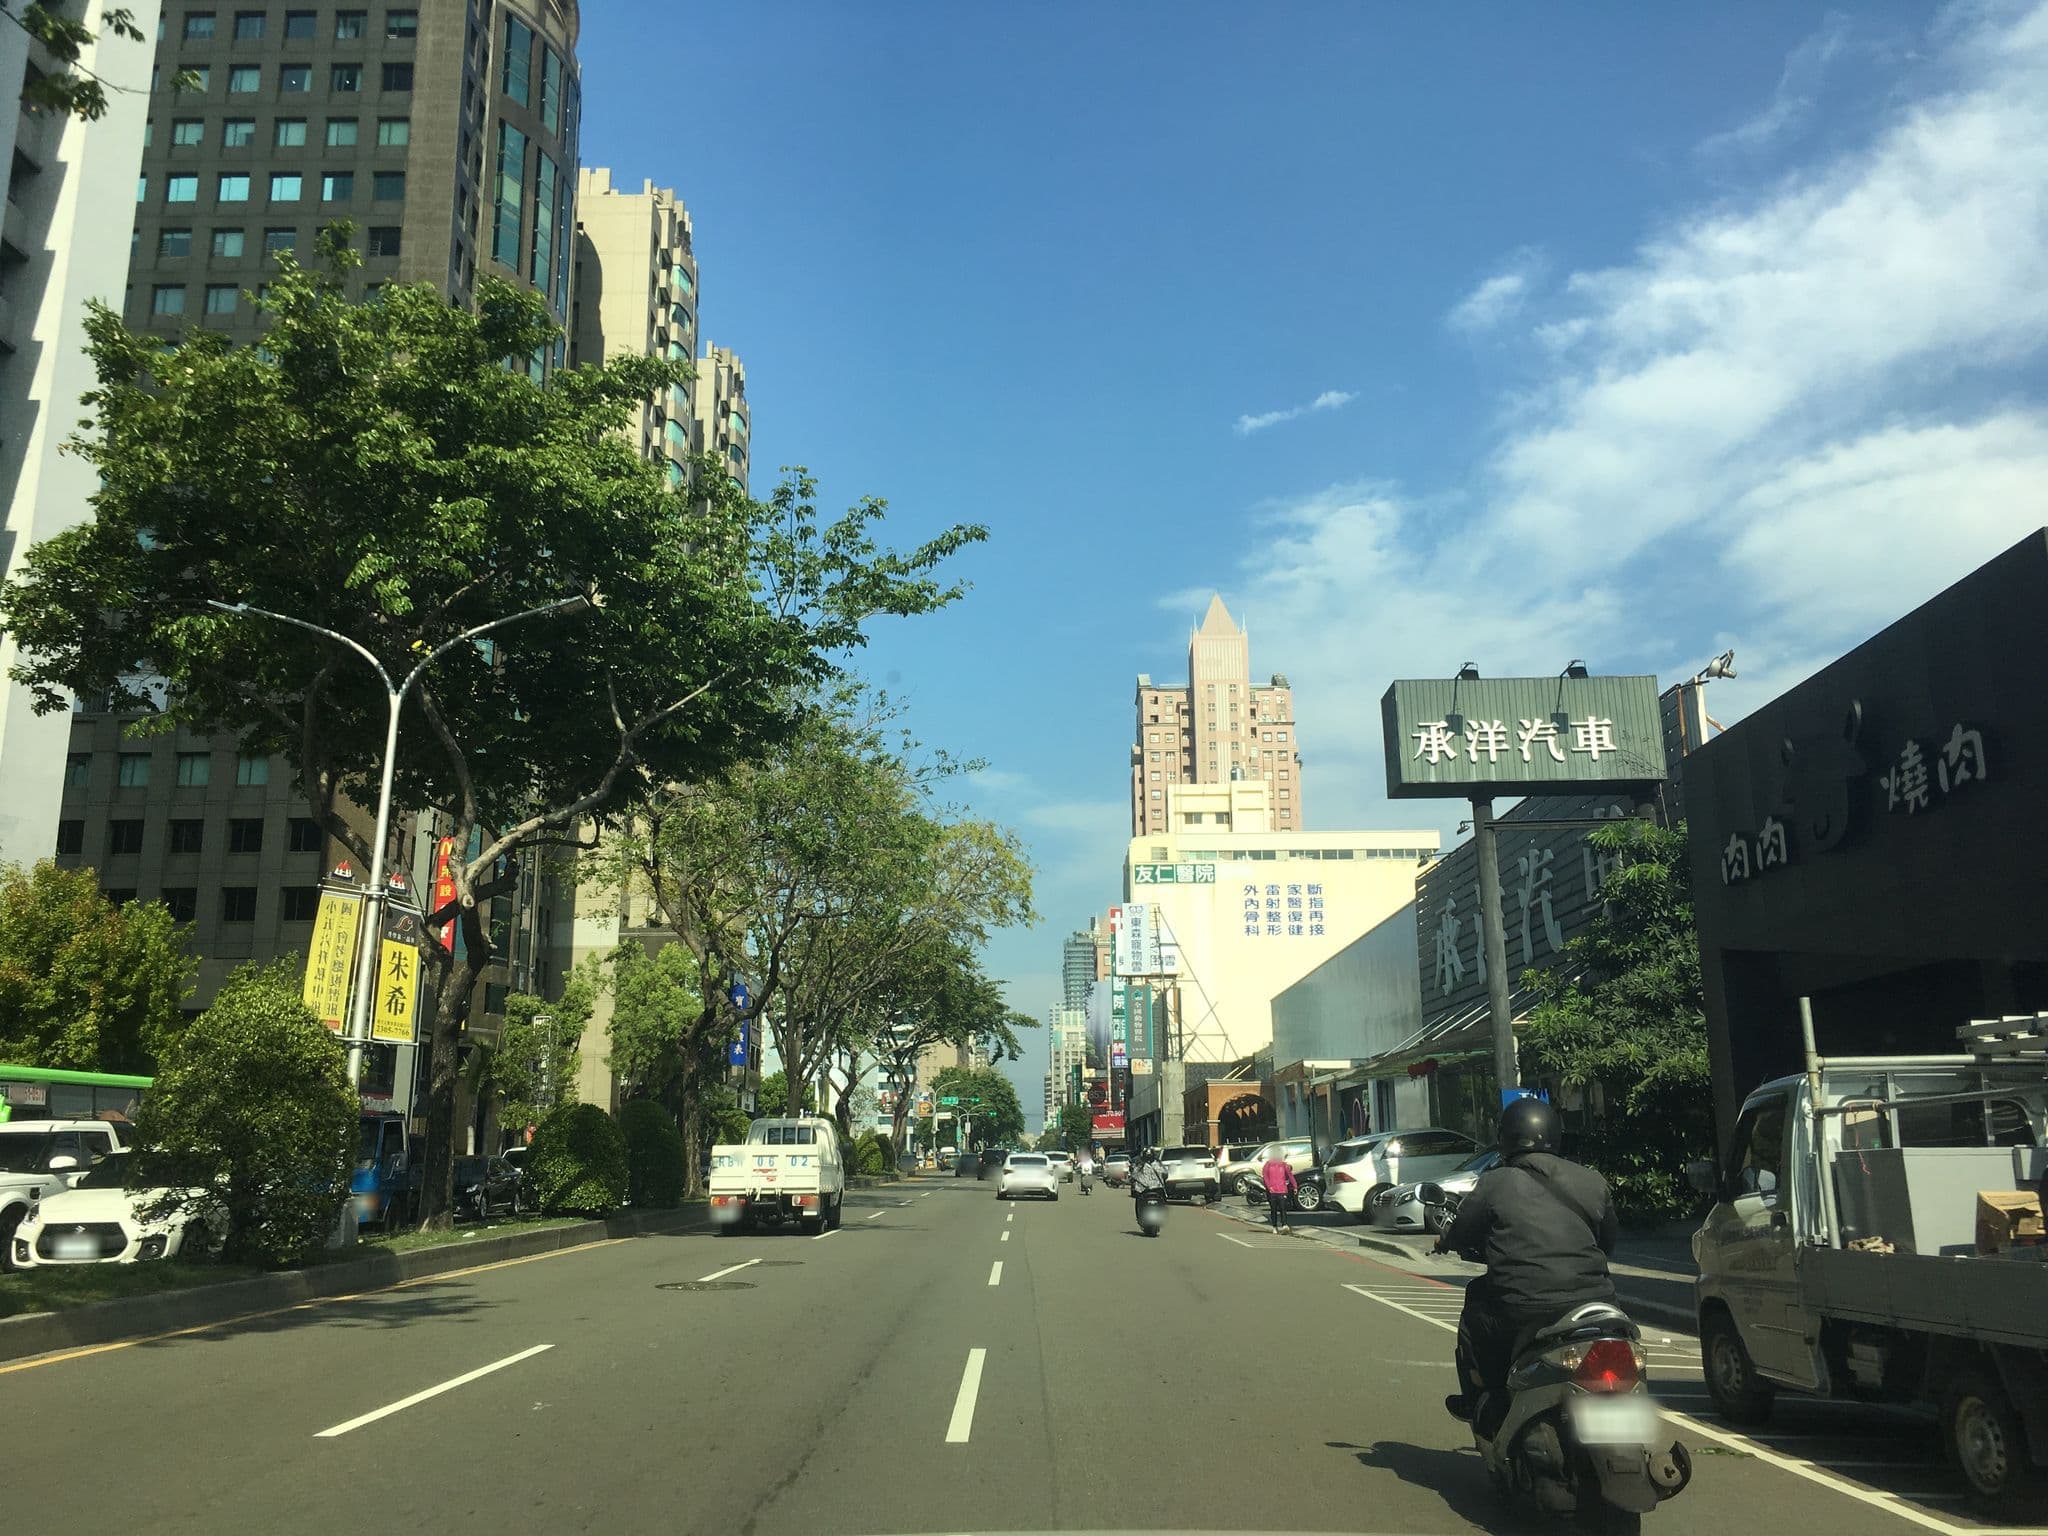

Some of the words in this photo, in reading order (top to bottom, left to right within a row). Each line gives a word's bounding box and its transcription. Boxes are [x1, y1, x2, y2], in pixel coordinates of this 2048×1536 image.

[1412, 715, 1617, 765] 承洋汽車
[1721, 815, 1788, 886] 肉肉
[1880, 722, 1987, 816] 燒肉
[1135, 865, 1215, 883] 友仁醫院
[1265, 884, 1282, 936] 雷射整形
[1287, 883, 1304, 936] 家醫復健
[1307, 883, 1325, 936] 斷指再接
[1130, 918, 1143, 972] 東森寵物雲
[384, 951, 409, 1016] 朱希
[718, 1157, 743, 1168] RB
